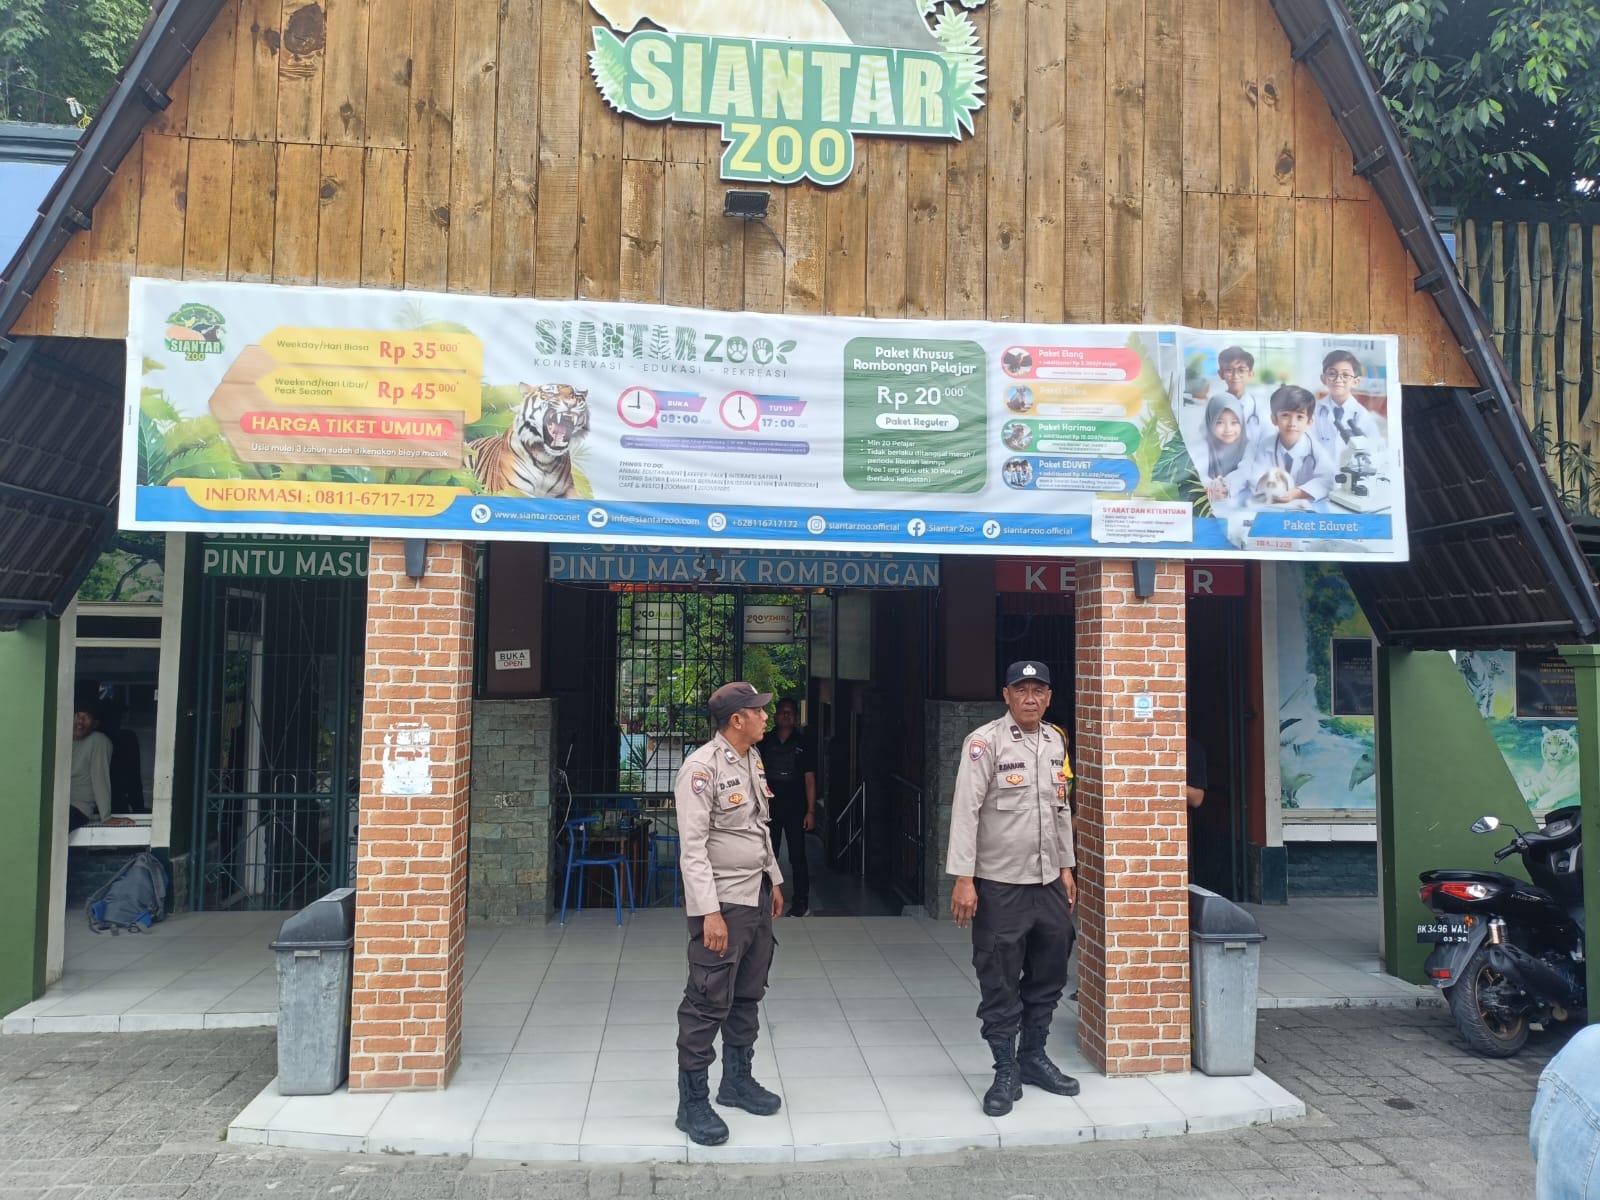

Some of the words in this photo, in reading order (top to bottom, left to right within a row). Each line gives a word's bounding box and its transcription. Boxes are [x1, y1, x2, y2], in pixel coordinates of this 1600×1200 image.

[630, 38, 944, 127] SIANTAR
[730, 122, 845, 176] ZOO
[171, 341, 220, 353] SIANTAR
[344, 343, 369, 351] Biasa
[379, 341, 406, 365] Rp
[704, 334, 774, 365] ZOO
[875, 346, 909, 359] Paket
[913, 348, 955, 360] Khusus
[186, 352, 205, 361] ZOO
[1038, 349, 1060, 358] Paket
[1062, 350, 1084, 360] Elang
[533, 358, 622, 371] KONSERVASI
[643, 363, 701, 375] EDUKASI
[723, 367, 788, 378] REKREASI
[853, 359, 928, 374] Rombongan
[931, 361, 977, 377] Pelajar
[274, 387, 296, 395] Peak
[299, 388, 332, 396] Season
[378, 381, 405, 405] Rp
[877, 386, 909, 410] Rp
[667, 400, 689, 408] BUKA
[661, 414, 699, 424] 09:00
[762, 418, 796, 428] 17:00
[885, 417, 911, 426] Paket
[913, 418, 949, 429] Reguler
[252, 416, 321, 432] HARGA
[326, 418, 377, 434] TIKET
[381, 421, 442, 437] UMUM
[1038, 423, 1061, 432] Paket
[1062, 424, 1096, 432] Harimau
[251, 443, 269, 451] Usia
[271, 444, 295, 452] mulai
[303, 445, 327, 453] tahun
[329, 446, 353, 454] sudah
[354, 447, 396, 456] dikenakan
[398, 448, 421, 458] biaya
[1039, 460, 1061, 469] Paket
[1062, 461, 1092, 470] EDUVET
[205, 487, 302, 503] INFORMASI
[315, 490, 435, 508] 0811-6717-172
[494, 511, 581, 521] www.siantarzoo.net
[611, 514, 700, 526] info@siantarzoo.com
[828, 522, 900, 532] siantarzoo.official
[928, 524, 958, 534] Siantar
[959, 525, 975, 534] Zoo
[1003, 526, 1073, 536] siantarzoo.official
[1283, 519, 1316, 531] Paket
[1319, 520, 1359, 532] Eduvet
[203, 549, 285, 575] PINTU
[295, 551, 369, 577] MASU
[549, 556, 635, 580] PINTU
[648, 557, 747, 583] MASUK
[757, 559, 940, 587] ROMBONGAN
[499, 651, 525, 660] BUKA
[503, 660, 524, 668] OPEN
[1450, 923, 1469, 934] WAL
